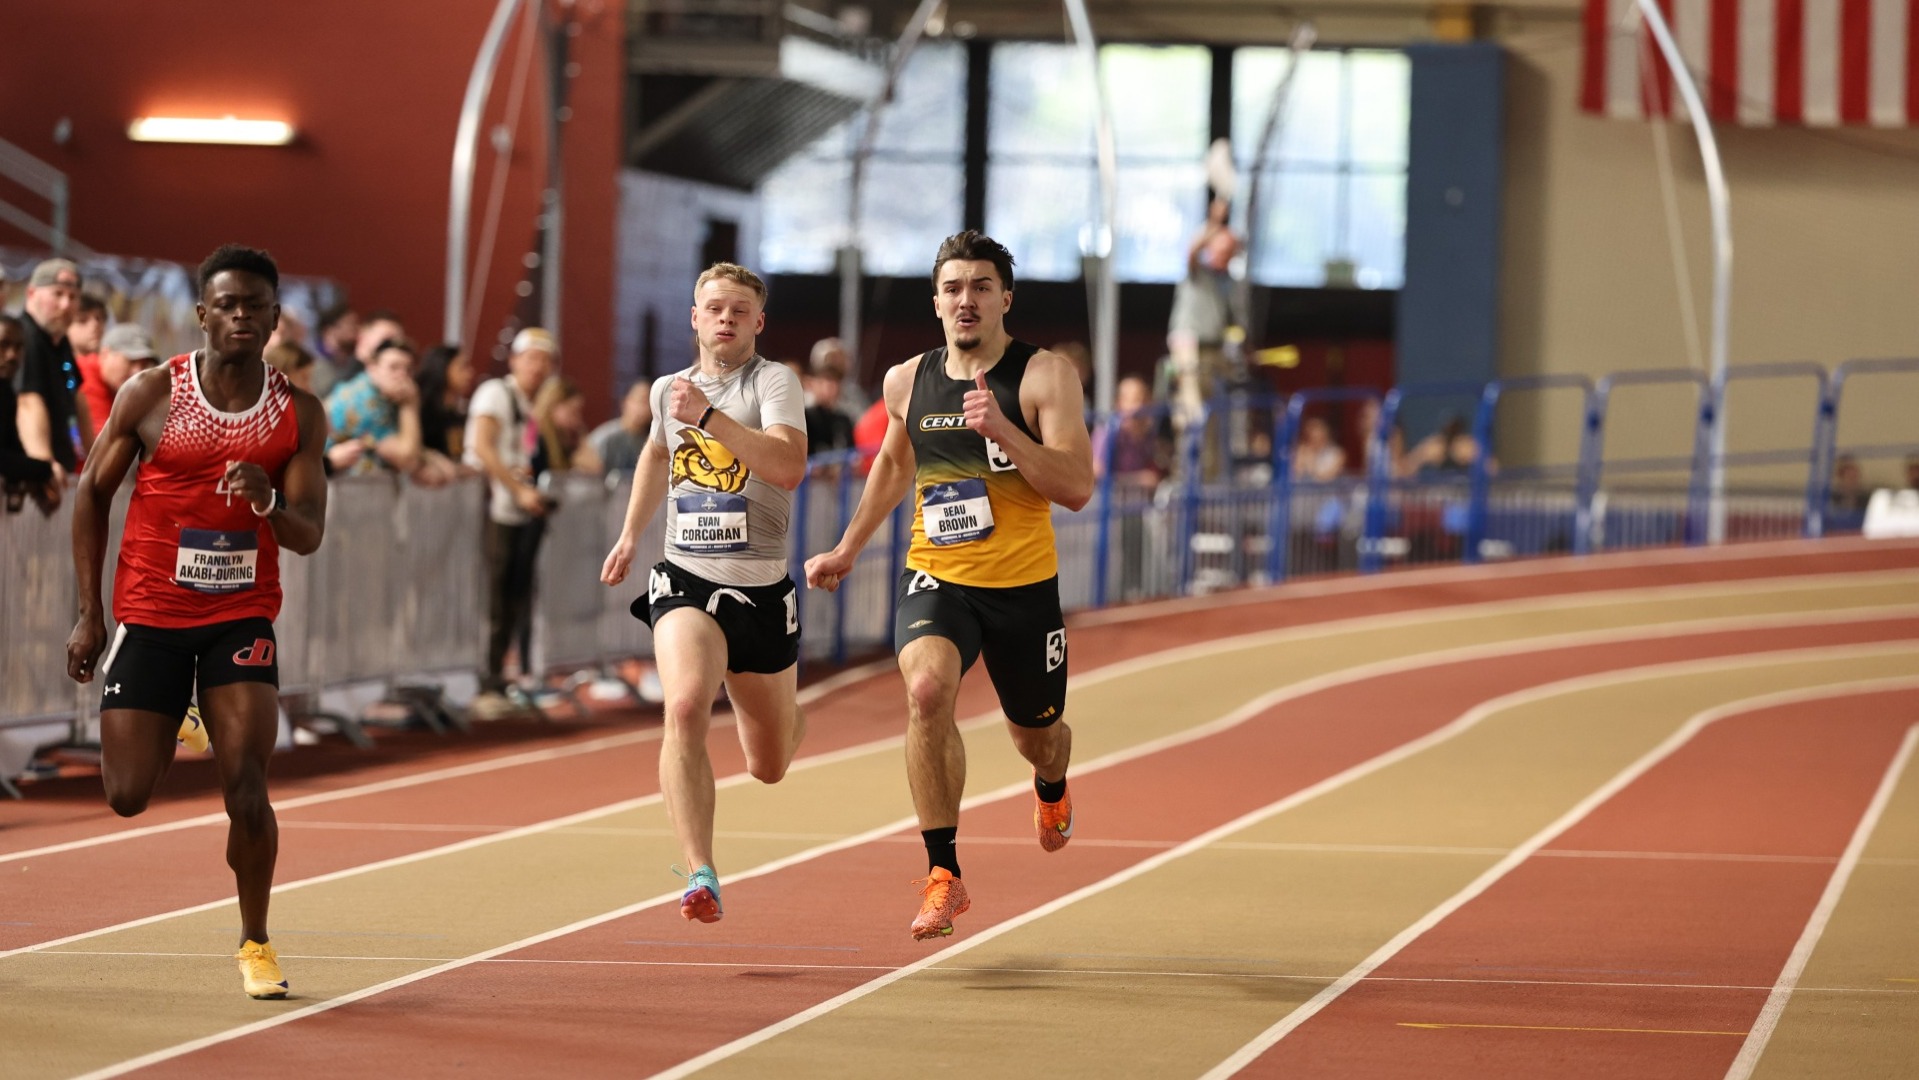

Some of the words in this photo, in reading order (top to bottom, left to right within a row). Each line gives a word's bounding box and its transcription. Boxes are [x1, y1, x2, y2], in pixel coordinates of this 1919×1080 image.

[943, 504, 966, 517] BEAU
[698, 516, 720, 527] EVAN
[938, 515, 978, 533] BROWN
[682, 528, 741, 541] CORCORAN
[194, 553, 243, 566] FRANKLYN
[180, 565, 253, 581] AKABI-DURING
[1049, 633, 1063, 667] 3
